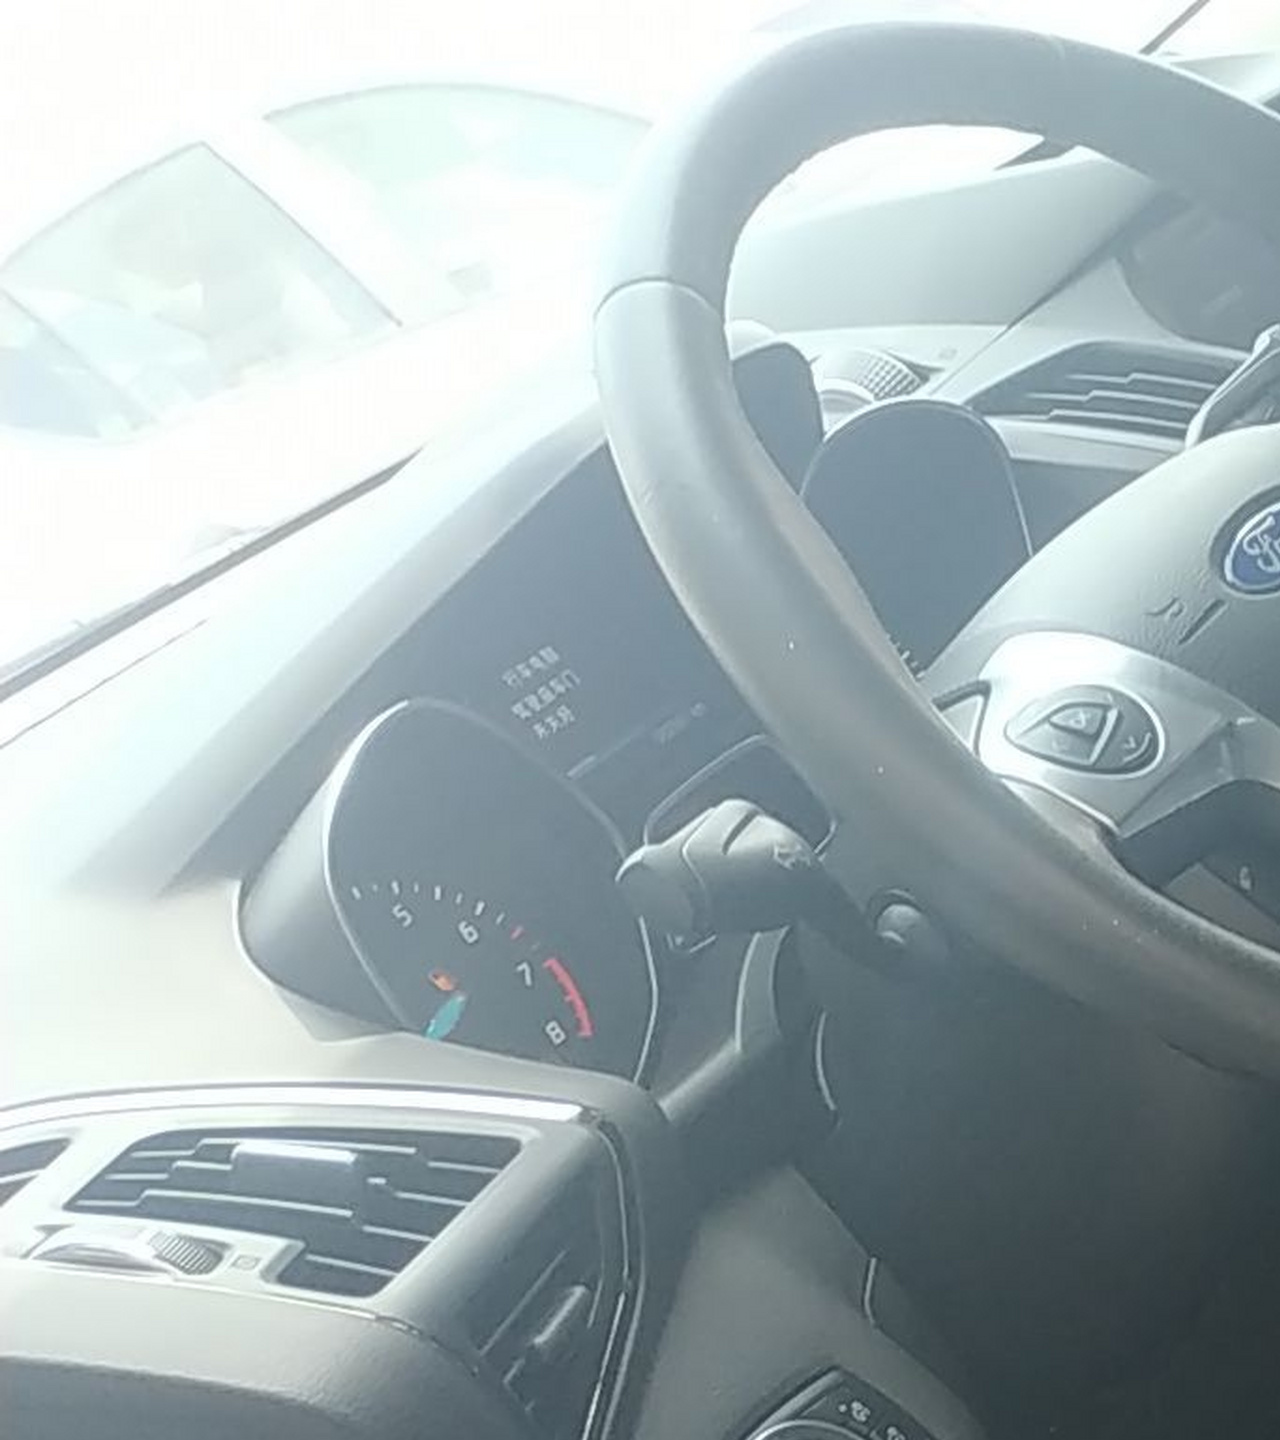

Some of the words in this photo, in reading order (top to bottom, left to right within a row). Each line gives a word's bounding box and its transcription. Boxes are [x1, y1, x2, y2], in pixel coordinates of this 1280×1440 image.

[392, 904, 413, 927] 5
[458, 920, 480, 944] 6
[516, 962, 533, 987] 7
[545, 1020, 567, 1045] 8
